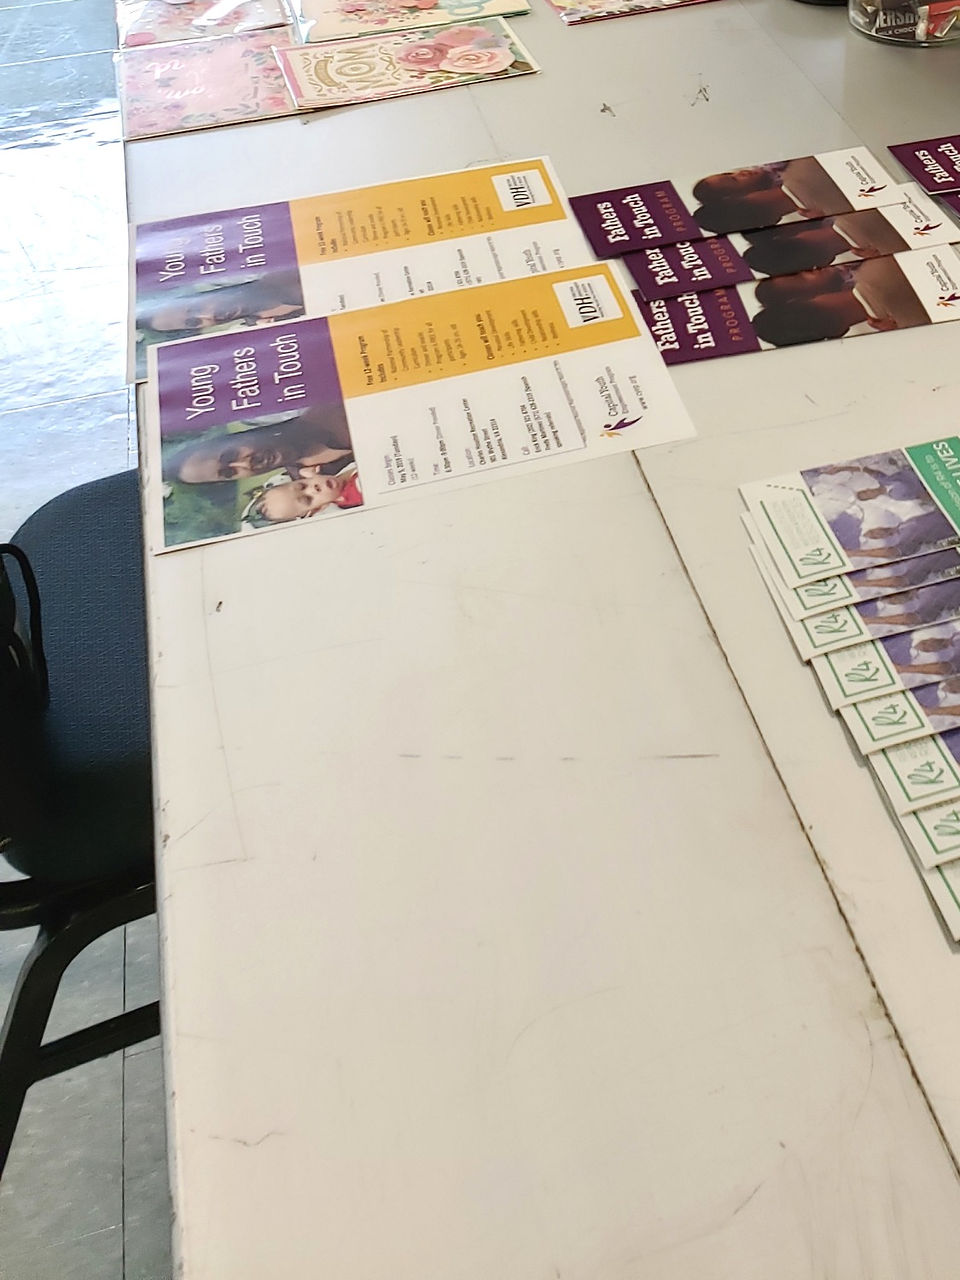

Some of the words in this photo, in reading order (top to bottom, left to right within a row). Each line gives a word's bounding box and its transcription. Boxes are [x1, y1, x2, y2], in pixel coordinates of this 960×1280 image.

[915, 150, 955, 184] Fathers
[509, 185, 532, 208] VDH
[596, 201, 630, 244] Fathers
[622, 193, 656, 228] Touch
[655, 190, 687, 232] PROGRAM
[237, 214, 264, 253] Touch
[642, 229, 663, 240] in
[200, 224, 227, 274] Fathers
[240, 253, 266, 268] in
[676, 242, 704, 269] Touc
[645, 248, 679, 286] Father
[691, 271, 713, 281] in
[573, 296, 600, 323] VDH
[677, 292, 710, 333] Touch
[649, 299, 680, 352] Fathers
[693, 333, 716, 349] in
[269, 333, 303, 384] Touch
[185, 363, 220, 420] Young
[228, 346, 261, 411] Fathers
[277, 382, 306, 402] in
[799, 547, 832, 566] R4
[814, 613, 848, 634] R4
[844, 660, 880, 682] R4
[872, 703, 908, 726] R4
[907, 760, 945, 785] R4
